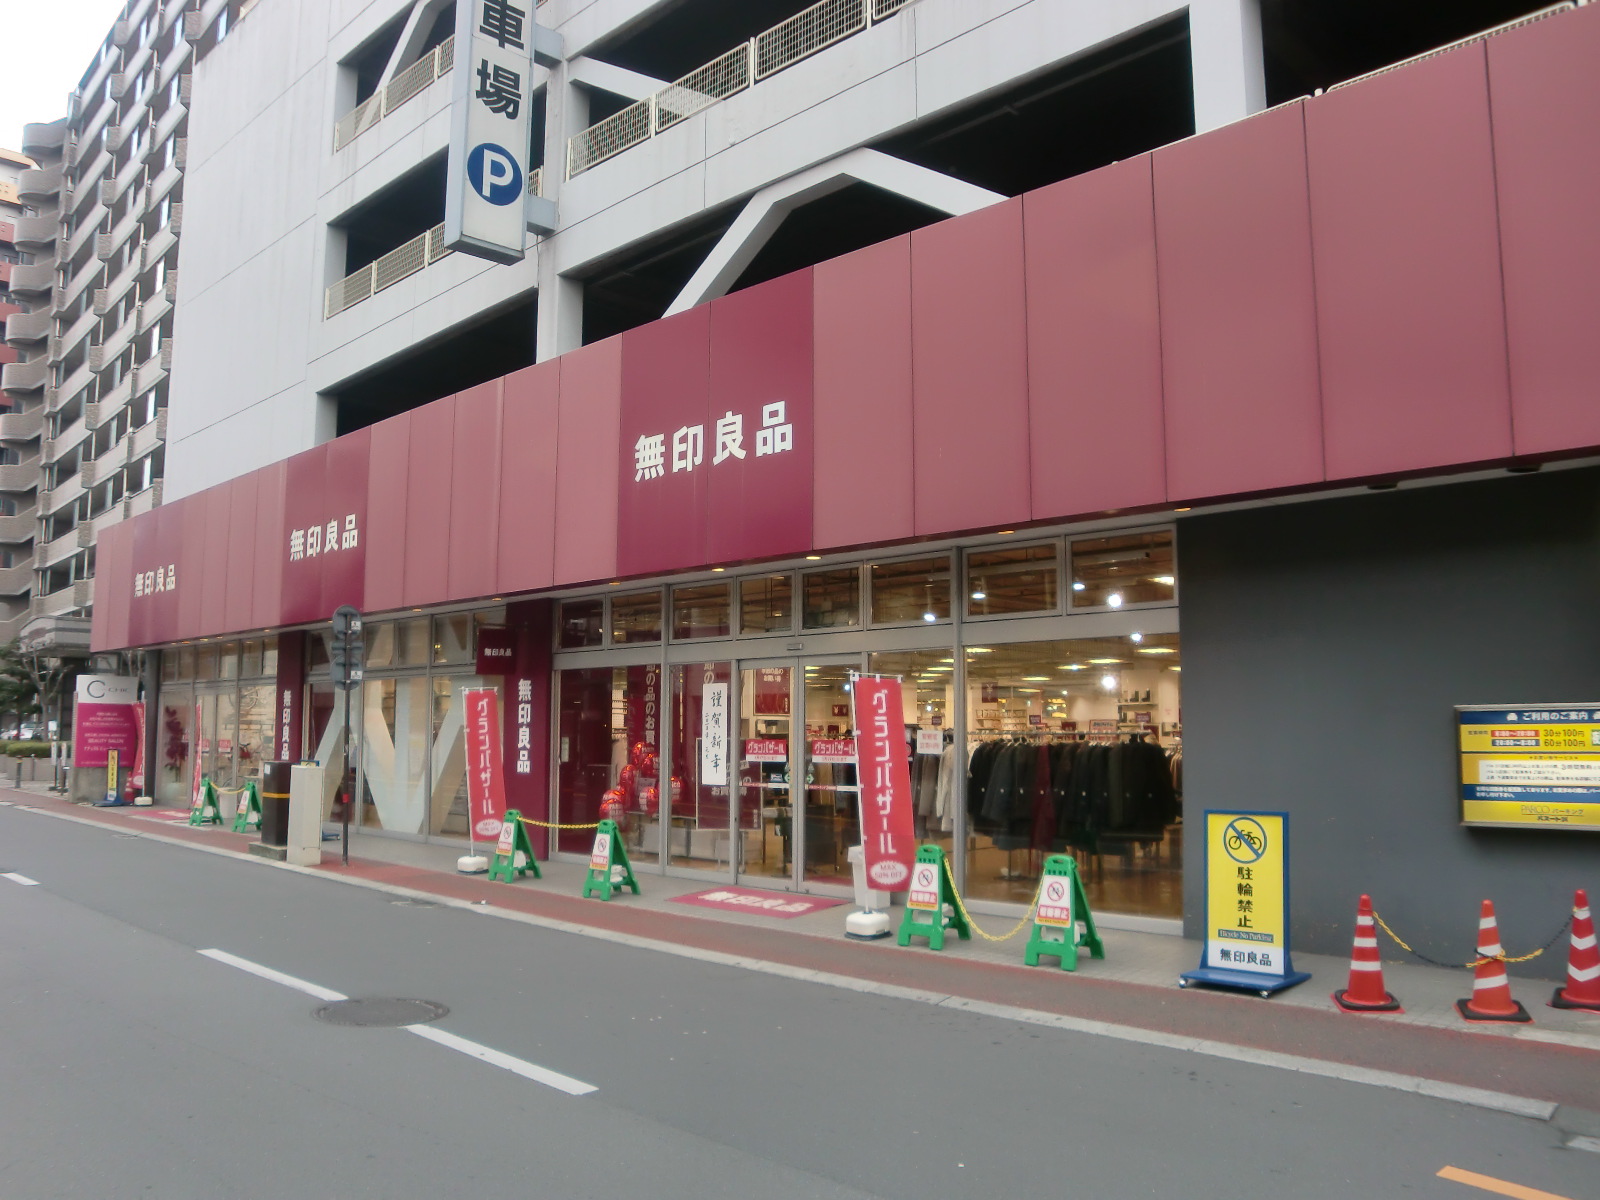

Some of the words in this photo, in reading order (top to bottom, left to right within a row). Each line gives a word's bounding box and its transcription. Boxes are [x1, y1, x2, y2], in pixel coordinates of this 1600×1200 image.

[482, 148, 513, 198] P
[634, 401, 793, 482] 無印良品
[290, 514, 358, 562] 無印良品
[134, 564, 176, 598] 無印良品
[484, 648, 512, 657] 無印良品
[281, 690, 291, 761] 無印良品
[517, 679, 532, 773] 無印良品
[1522, 711, 1588, 721] ご利用のご案内
[477, 698, 495, 815] グランバザール
[748, 742, 785, 754] グランバザール
[873, 689, 897, 854] グランバザール
[1237, 867, 1253, 928] 駐輪禁止
[1220, 948, 1272, 967] 無印良品
[1240, 931, 1250, 939] No
